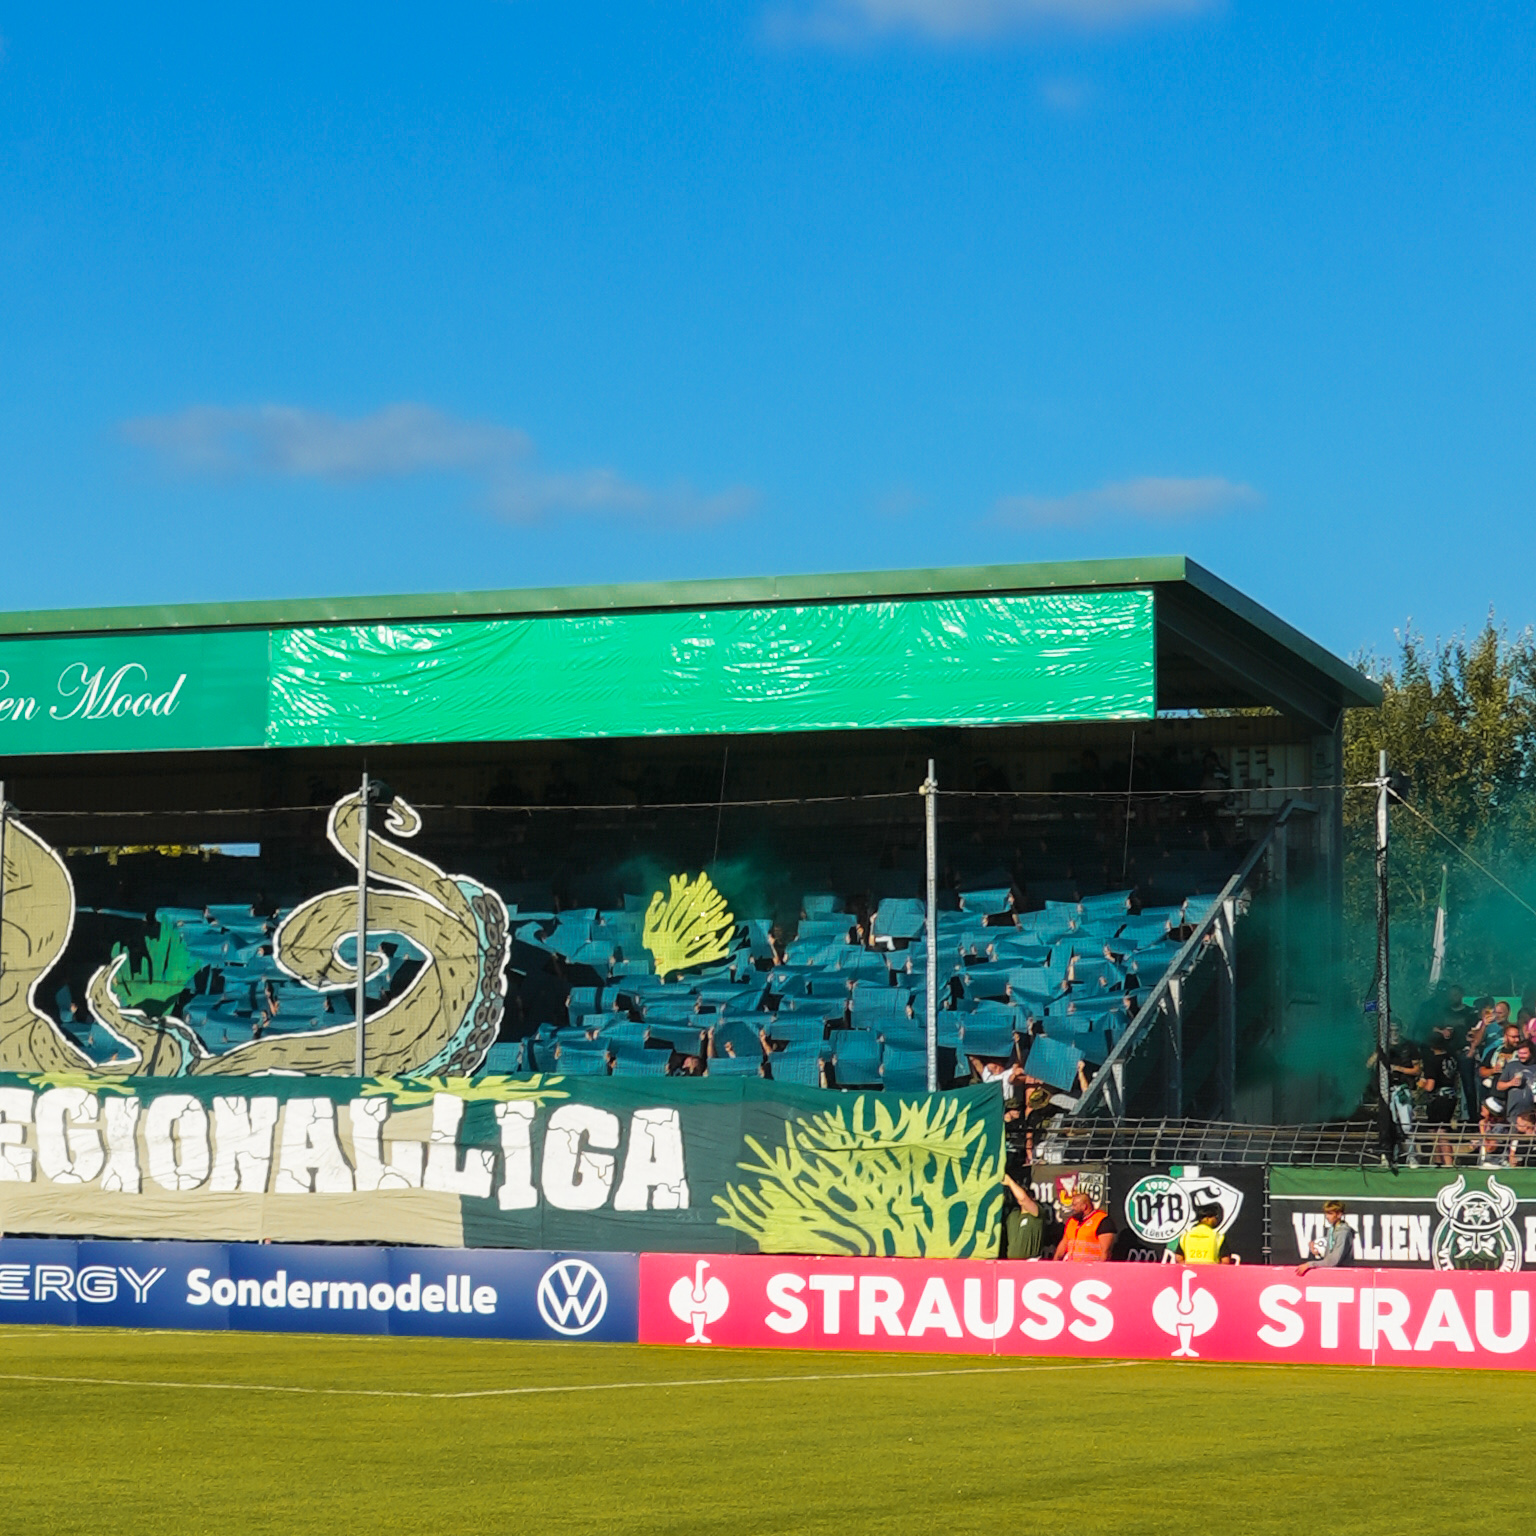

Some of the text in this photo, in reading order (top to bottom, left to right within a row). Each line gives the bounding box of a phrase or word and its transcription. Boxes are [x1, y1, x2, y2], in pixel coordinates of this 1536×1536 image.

[49, 662, 187, 722] Mood
[1189, 1249, 1209, 1259] 287
[1292, 1212, 1430, 1262] VIALIEN
[186, 1267, 498, 1315] Sondermodelle
[764, 1272, 1114, 1342] STRAUSS
[1257, 1284, 1536, 1354] STRAU
